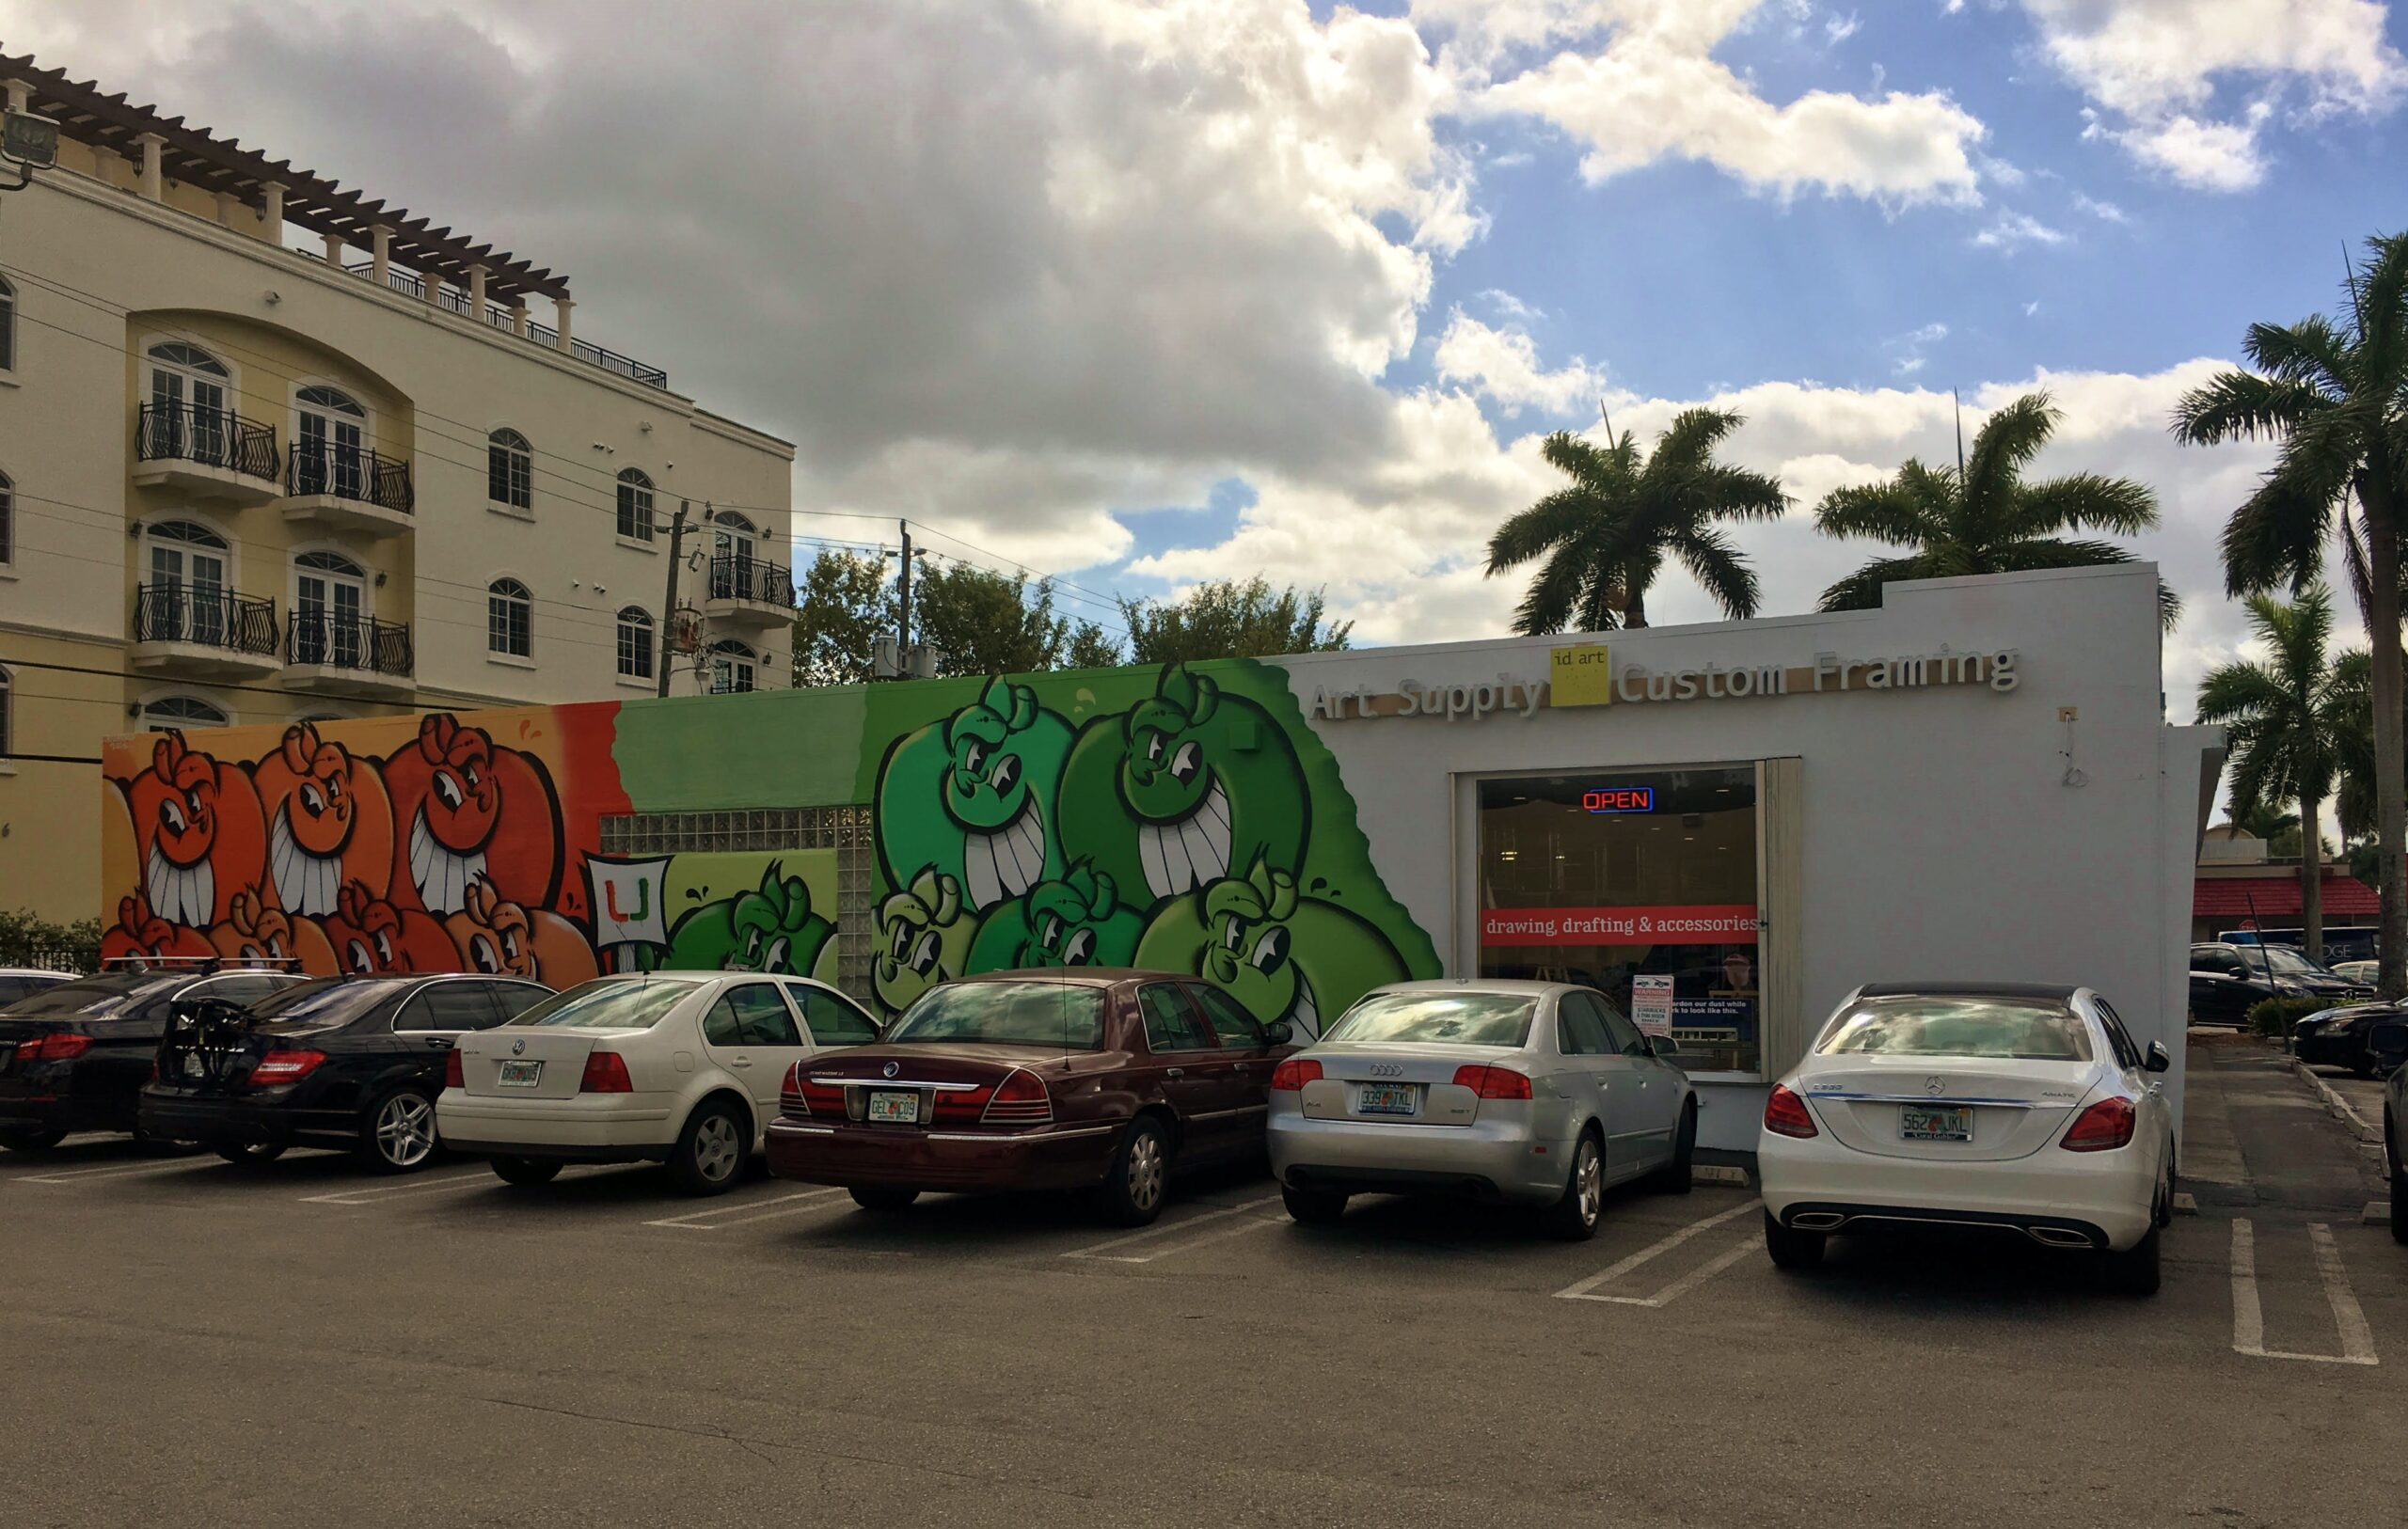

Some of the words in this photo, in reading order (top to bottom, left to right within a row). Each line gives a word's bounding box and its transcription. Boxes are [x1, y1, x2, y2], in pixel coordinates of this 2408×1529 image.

[1555, 652, 1572, 666] id
[1578, 651, 1605, 664] art
[1617, 661, 1785, 701] Custom
[1814, 643, 2020, 692] Framing
[1310, 684, 1378, 720] Art
[1398, 672, 1548, 721] Supply
[1583, 792, 1648, 809] OPEN
[605, 877, 649, 922] U
[1487, 918, 1558, 937] drawing,
[1562, 917, 1634, 936] drafting
[1639, 917, 1652, 933] &
[1656, 915, 1757, 932] accessories
[2322, 944, 2352, 958] DGE
[872, 1100, 887, 1114] GEL
[1362, 1091, 1382, 1105] 339
[1393, 1092, 1411, 1106] TKL
[1904, 1113, 1927, 1130] 562
[1946, 1115, 1968, 1133] JKL
